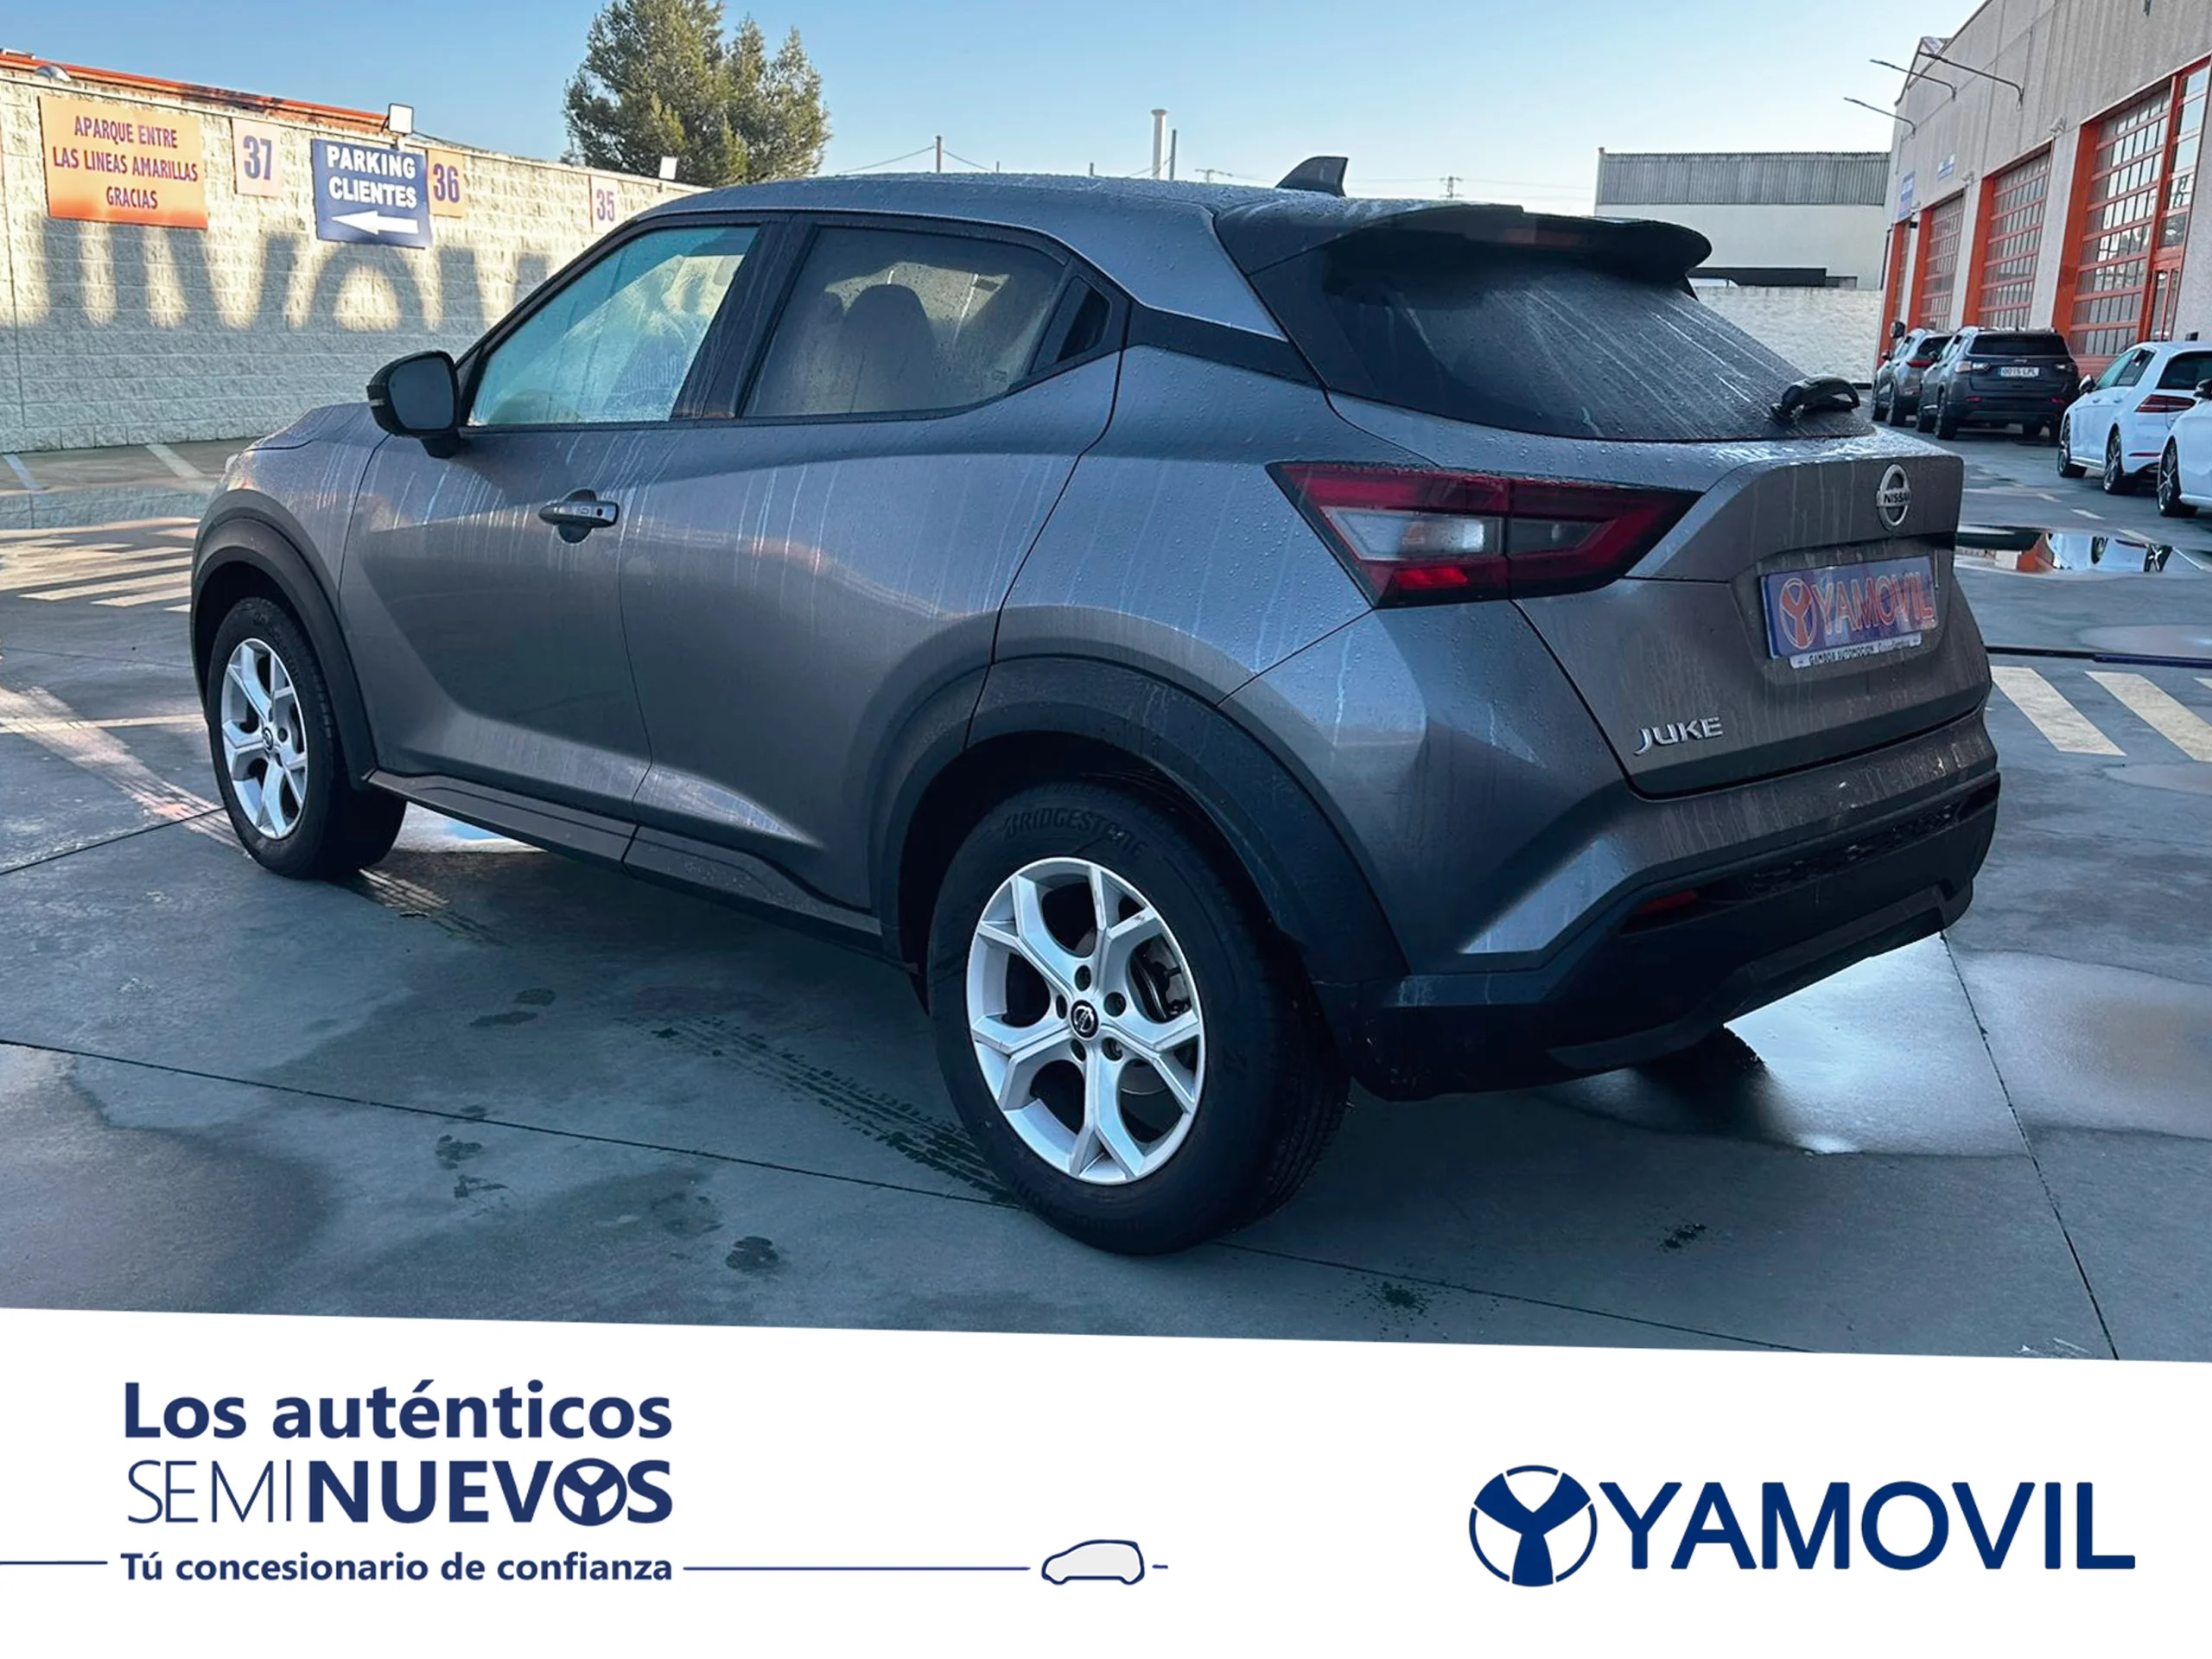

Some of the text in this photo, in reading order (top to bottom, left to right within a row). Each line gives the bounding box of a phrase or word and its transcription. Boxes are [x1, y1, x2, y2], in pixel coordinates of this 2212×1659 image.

[74, 116, 178, 149] APARQUE ENTRE
[53, 146, 199, 182] LAS LINEAS AMARILLAS
[243, 135, 272, 181] 37
[326, 144, 416, 179] PARKING
[106, 186, 158, 210] GRACIAS
[328, 176, 417, 209] CLIENTES
[433, 163, 460, 204] 36
[596, 188, 615, 222] 35
[1812, 572, 1934, 635] YAMOVIL
[1633, 716, 1724, 756] JUKE
[1003, 807, 1150, 857] BRIDGESTONE
